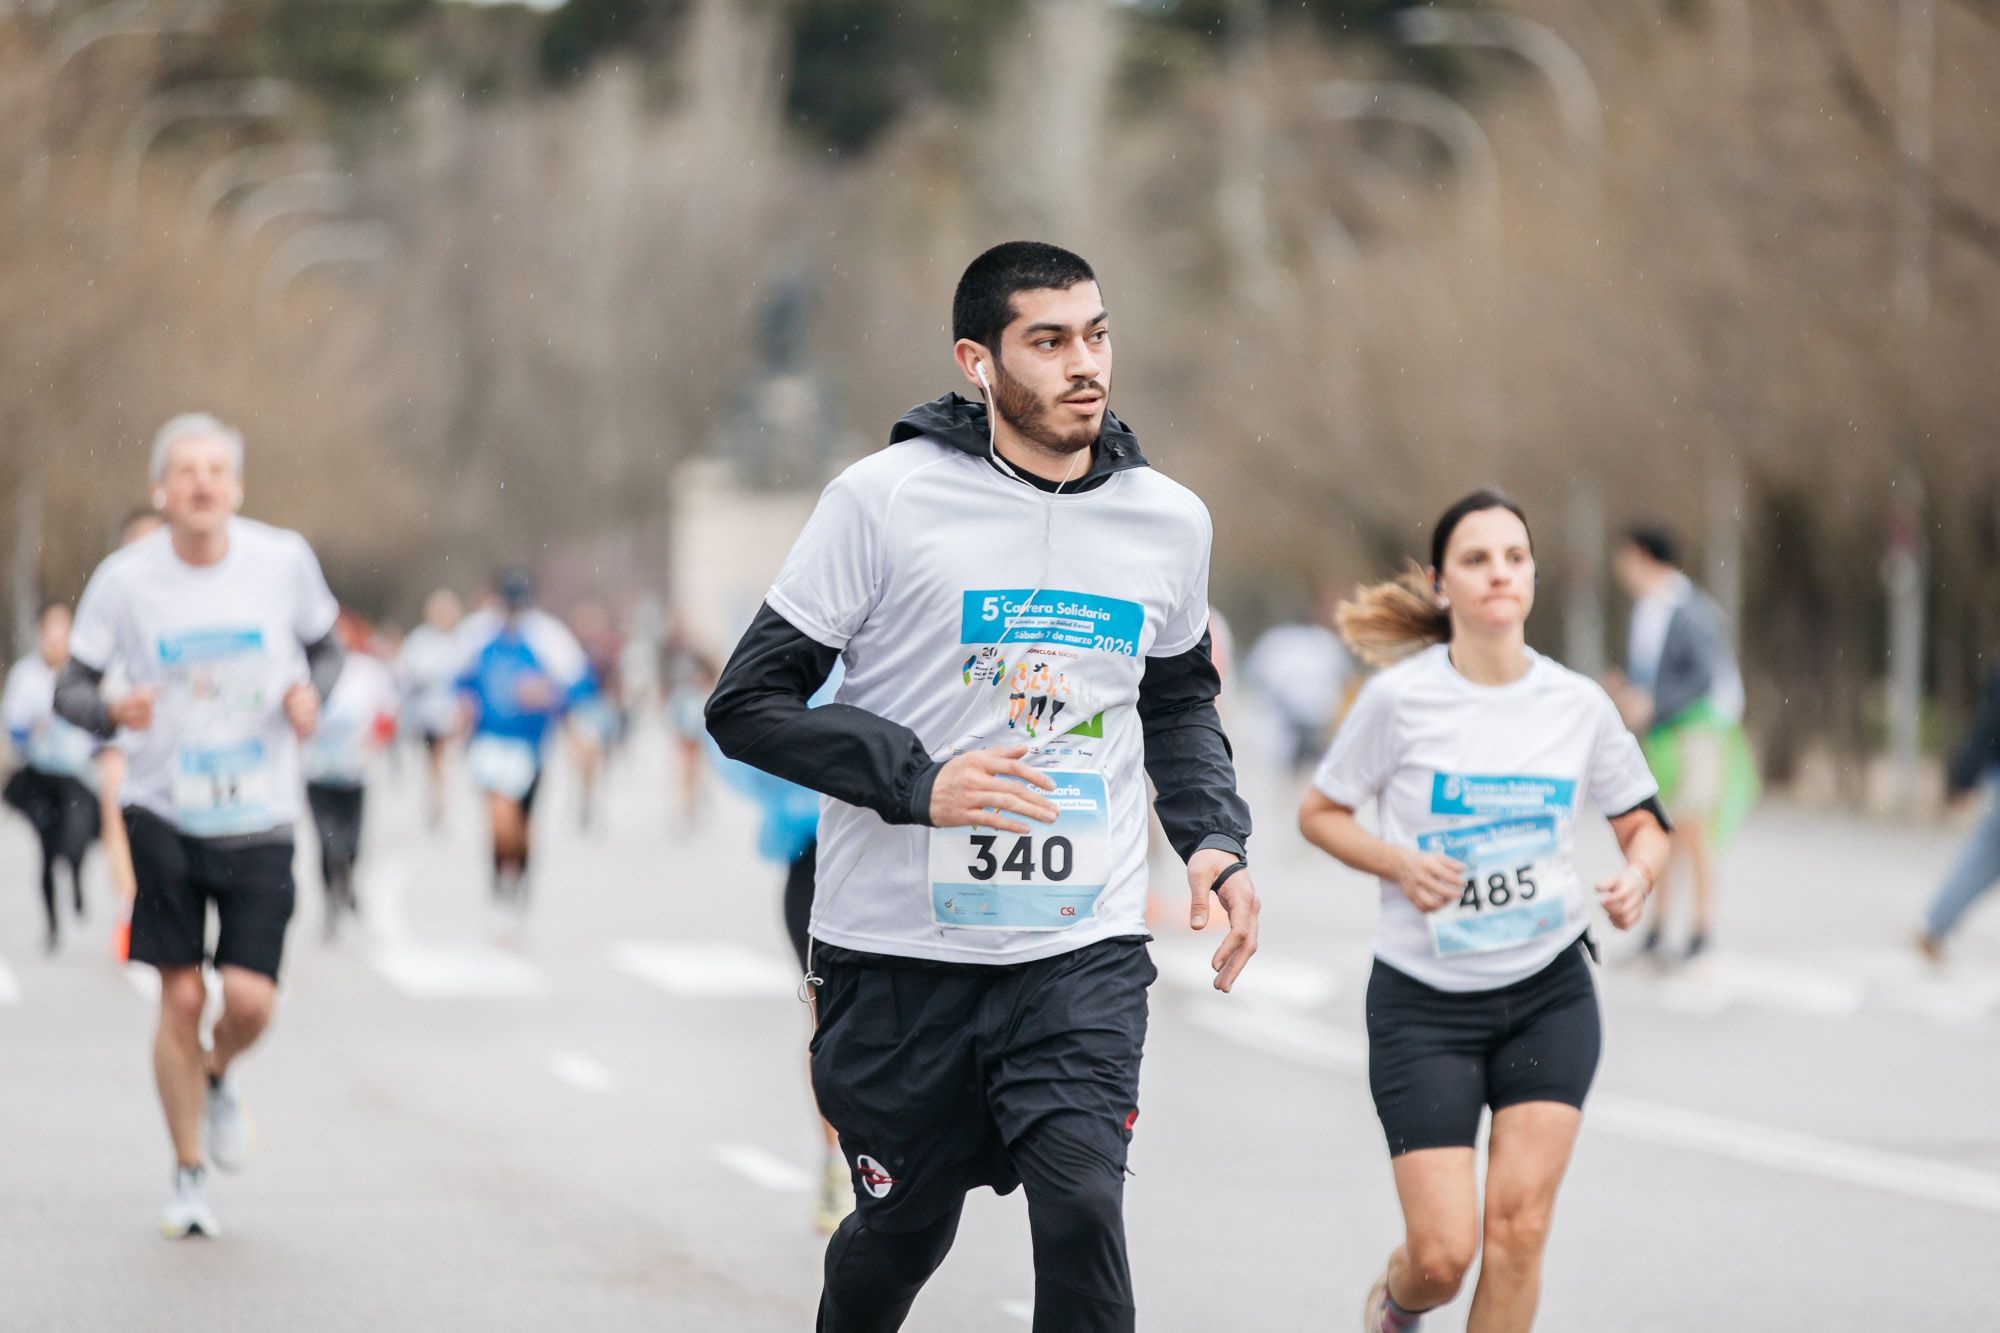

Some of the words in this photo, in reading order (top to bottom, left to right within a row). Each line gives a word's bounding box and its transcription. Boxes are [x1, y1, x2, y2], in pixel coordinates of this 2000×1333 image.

[1002, 601, 1054, 614] Carera
[1056, 601, 1111, 621] Solidaria
[1014, 630, 1044, 639] Sábado
[1045, 630, 1051, 639] 7
[1052, 631, 1064, 641] de
[1065, 634, 1092, 645] marzo
[1093, 634, 1133, 657] 2026
[967, 834, 1073, 882] 340
[1459, 863, 1535, 911] 485
[1060, 906, 1077, 916] CSL
